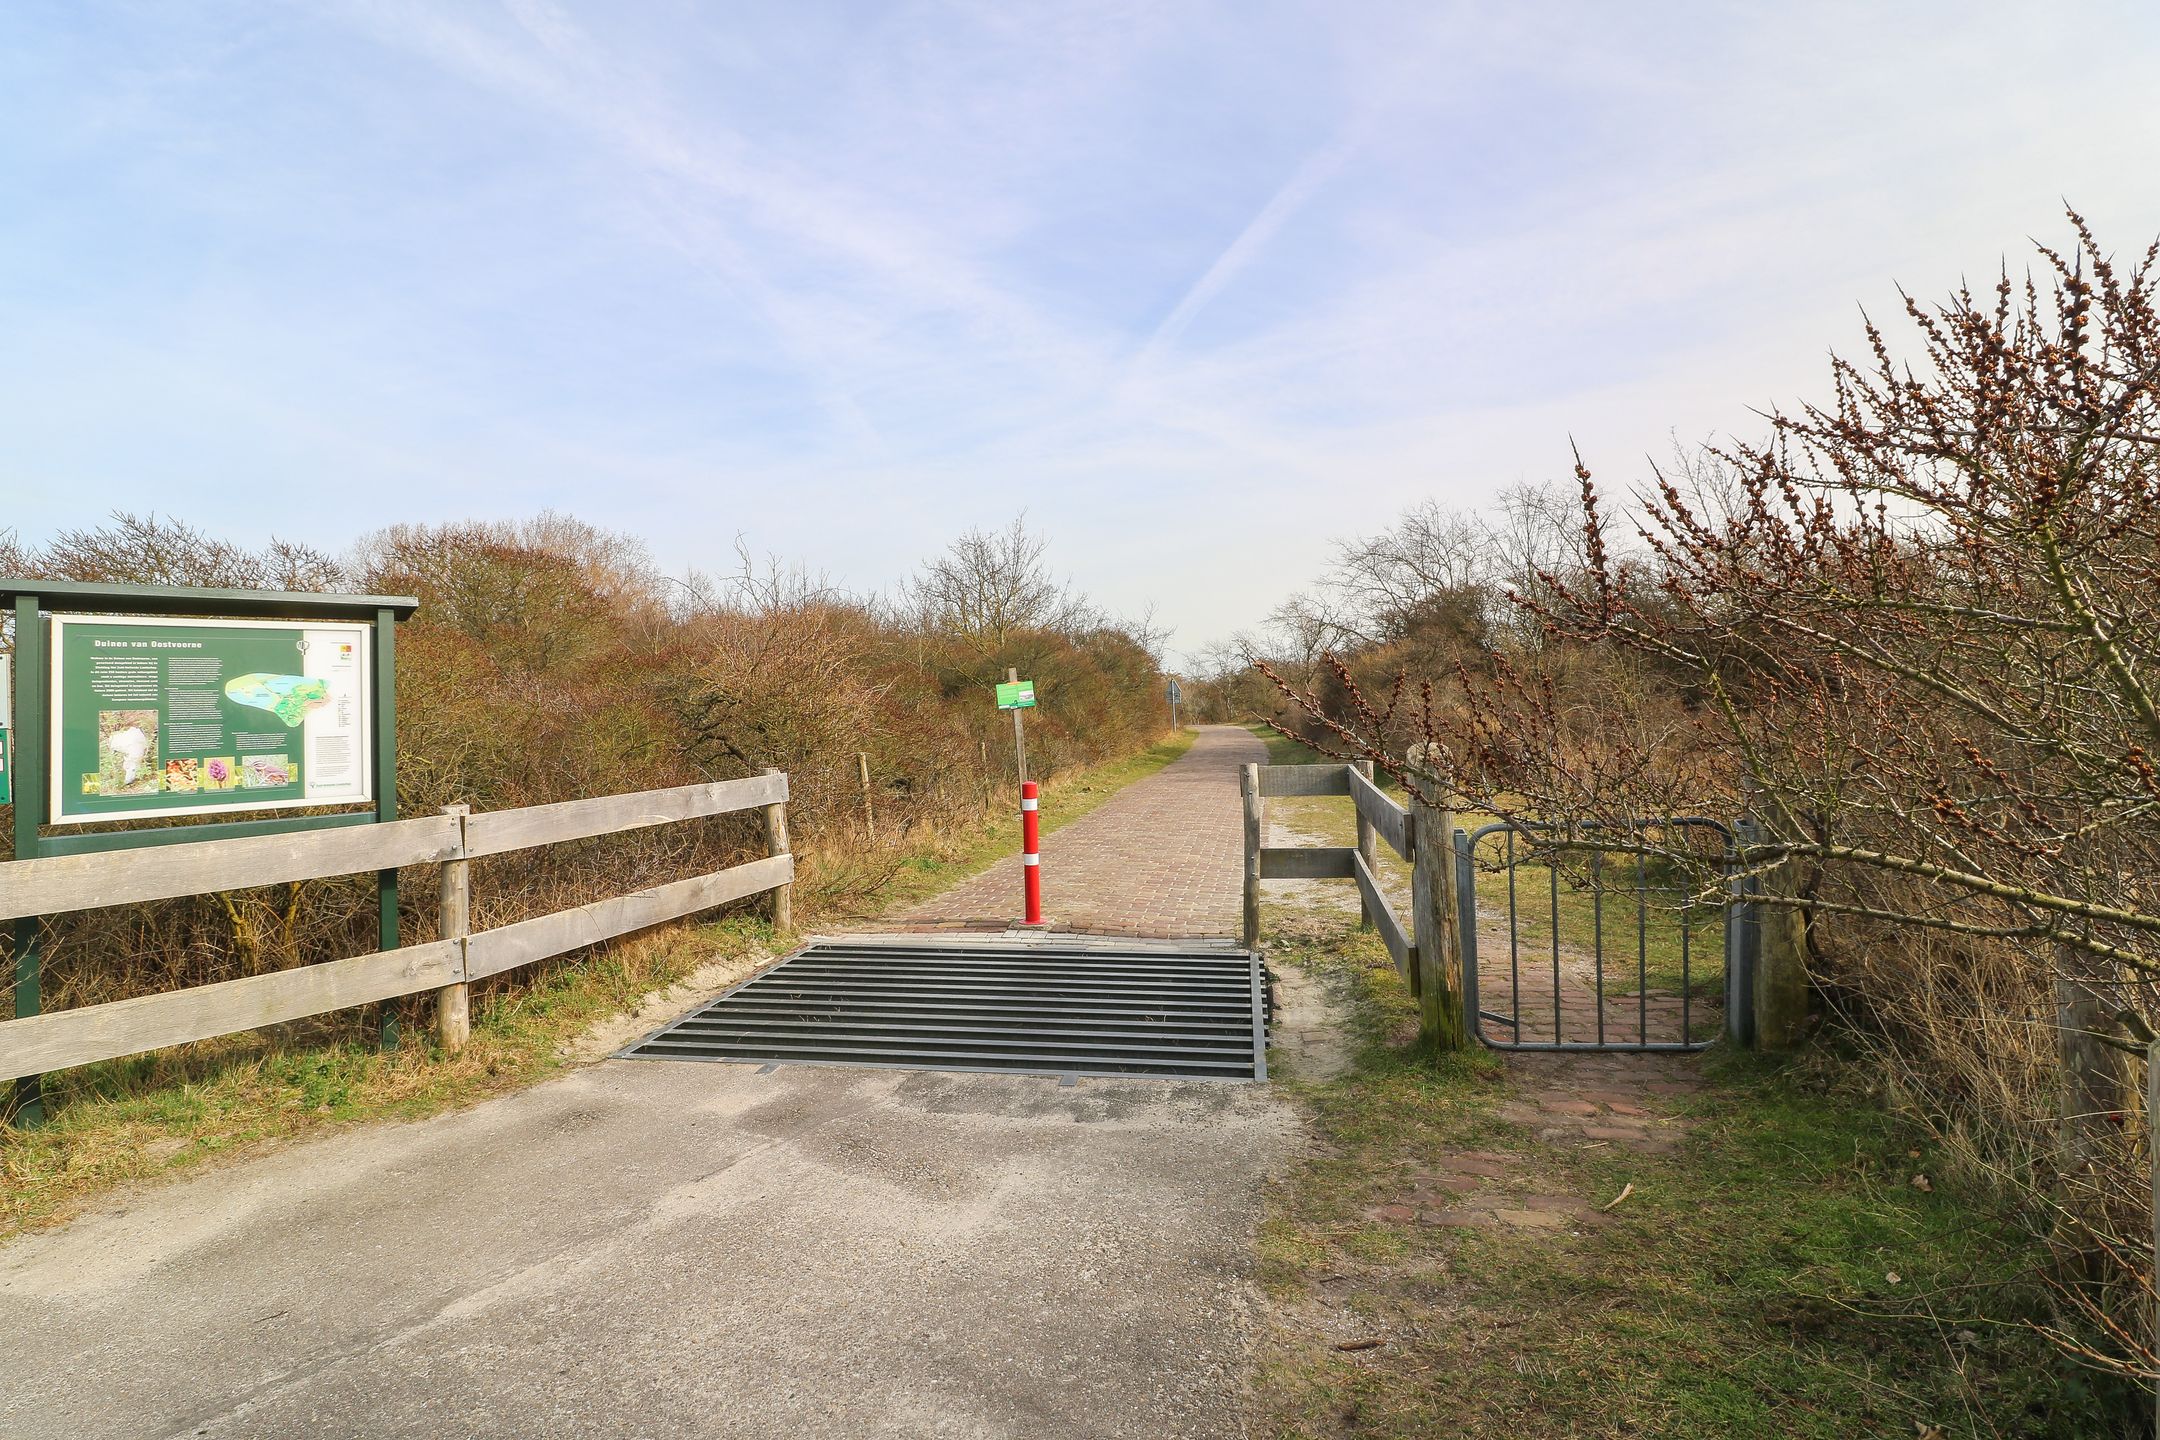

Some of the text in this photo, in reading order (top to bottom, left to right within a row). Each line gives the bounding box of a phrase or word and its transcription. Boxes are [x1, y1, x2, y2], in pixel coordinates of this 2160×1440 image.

[94, 639, 202, 649] Duinen van Oostvoorne
